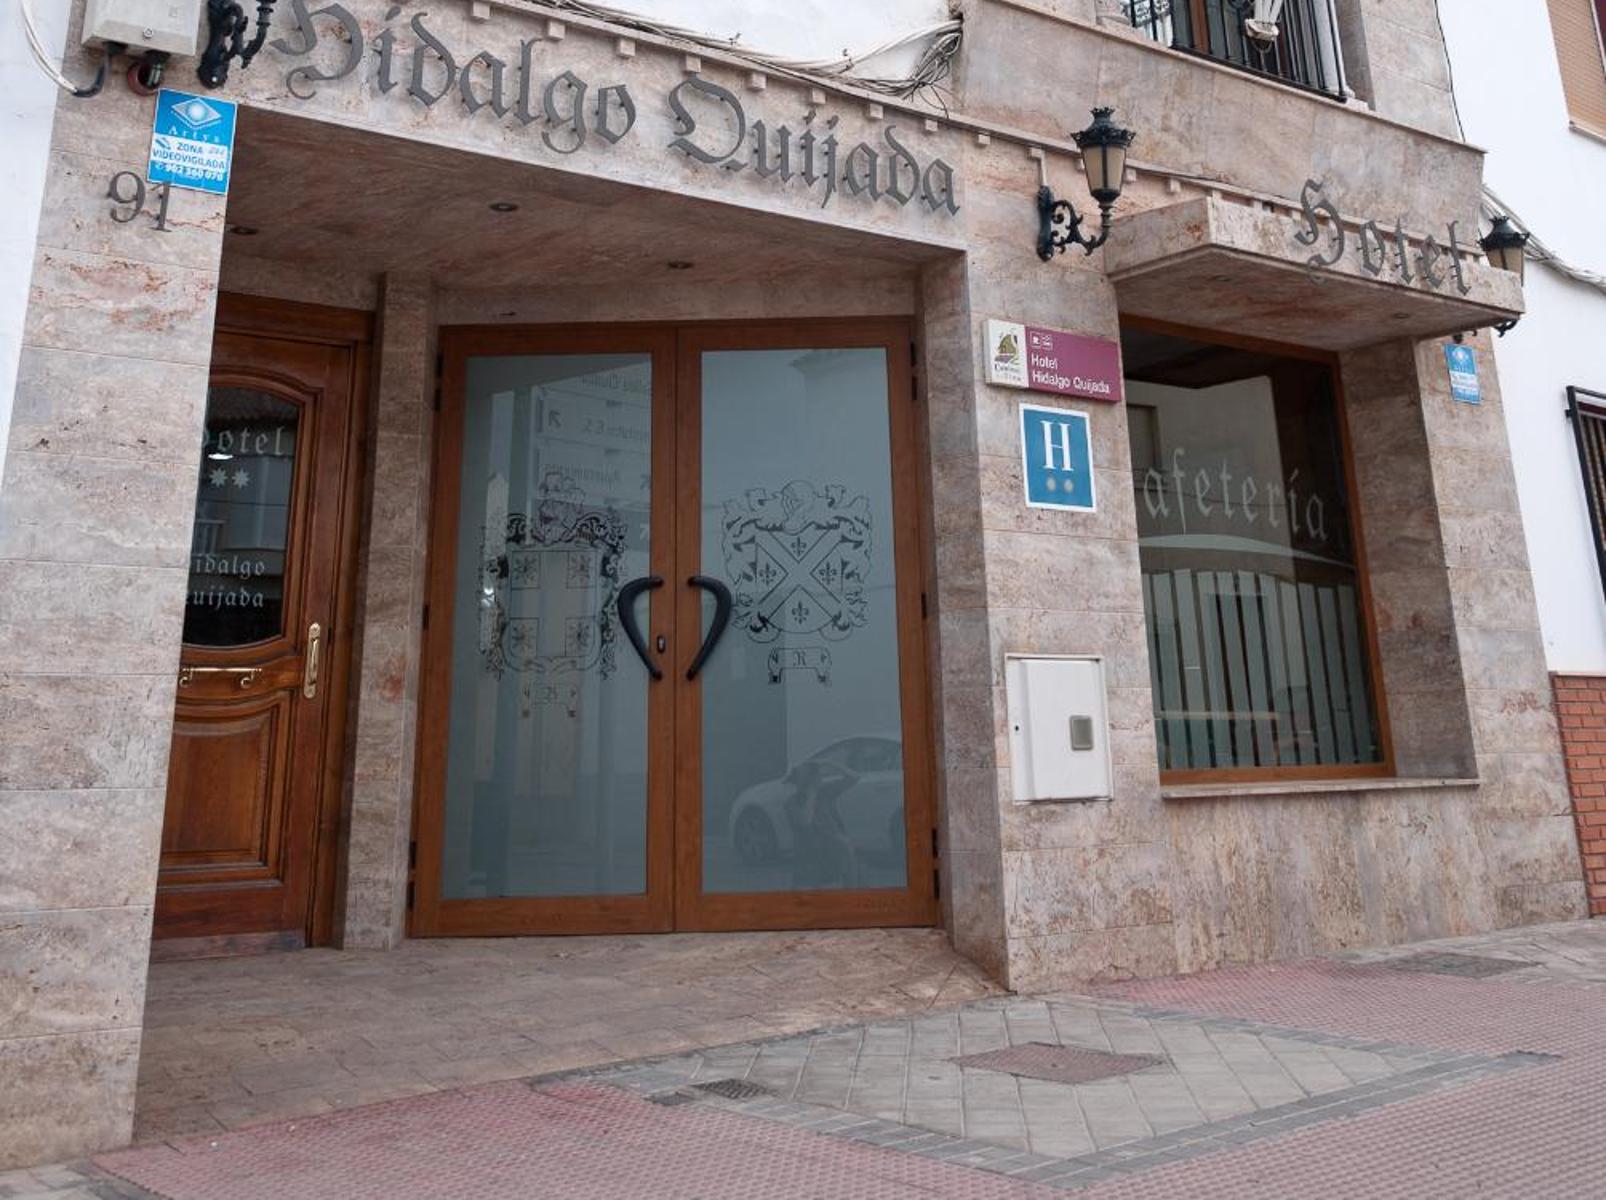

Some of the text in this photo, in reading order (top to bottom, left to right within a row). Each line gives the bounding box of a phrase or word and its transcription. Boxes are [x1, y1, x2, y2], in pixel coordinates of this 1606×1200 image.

[177, 141, 204, 155] ZONA
[667, 72, 961, 217] Quijada
[152, 147, 225, 171] VIDEOVIGILADA
[106, 171, 173, 233] 91
[1294, 178, 1472, 296] Hotel
[1031, 352, 1058, 370] Hotel
[1032, 369, 1071, 390] Hidalgo
[1073, 376, 1110, 395] Quijada
[1040, 419, 1075, 472] H
[1143, 447, 1328, 541] afetería
[196, 553, 265, 580] idalgo
[187, 584, 264, 610] uijada
